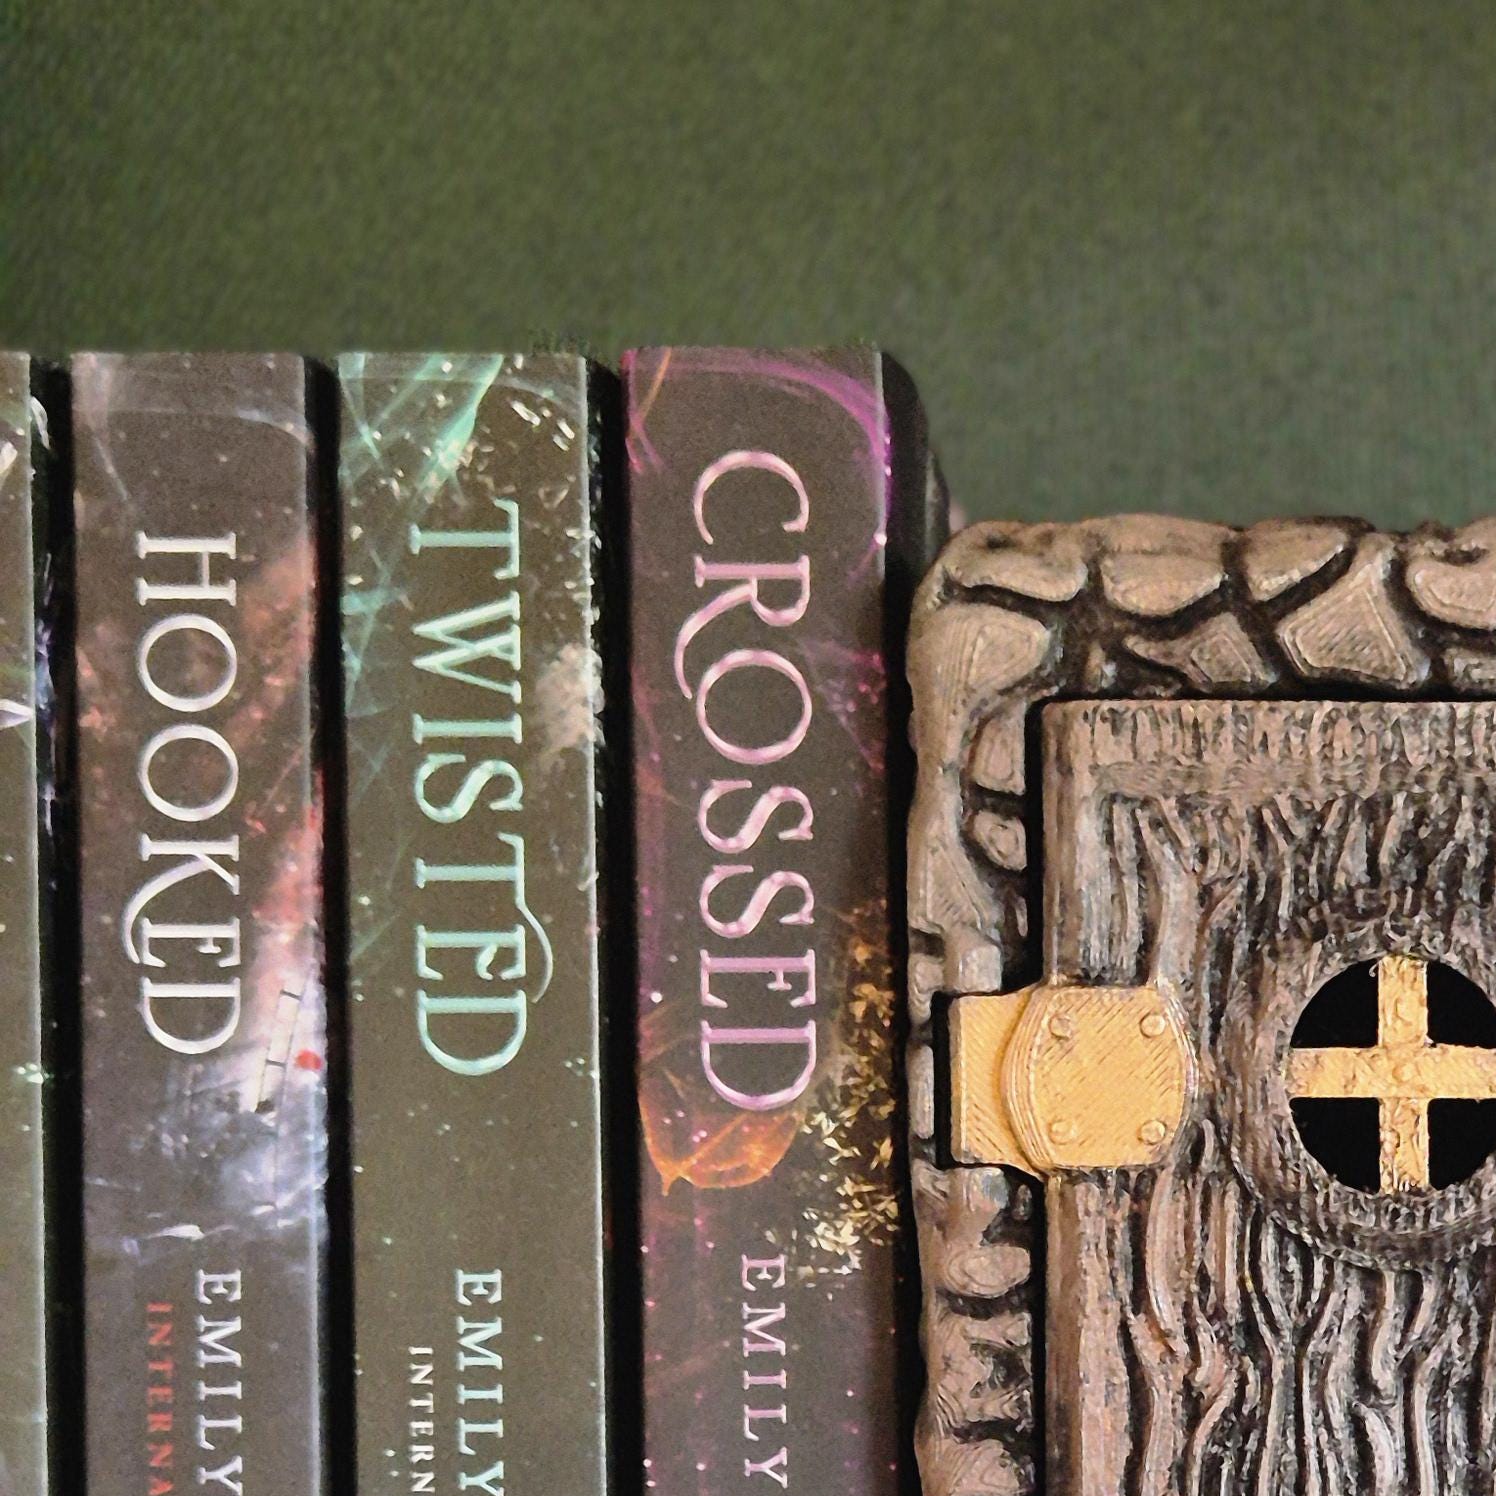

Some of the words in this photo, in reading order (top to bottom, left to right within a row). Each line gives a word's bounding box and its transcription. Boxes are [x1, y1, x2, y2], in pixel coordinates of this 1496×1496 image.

[122, 532, 241, 1055] HOOKED
[410, 499, 553, 1077] TWISTED
[674, 451, 818, 1111] CROSSED
[198, 1269, 244, 1496] EMILY
[740, 1253, 788, 1487] EMILY
